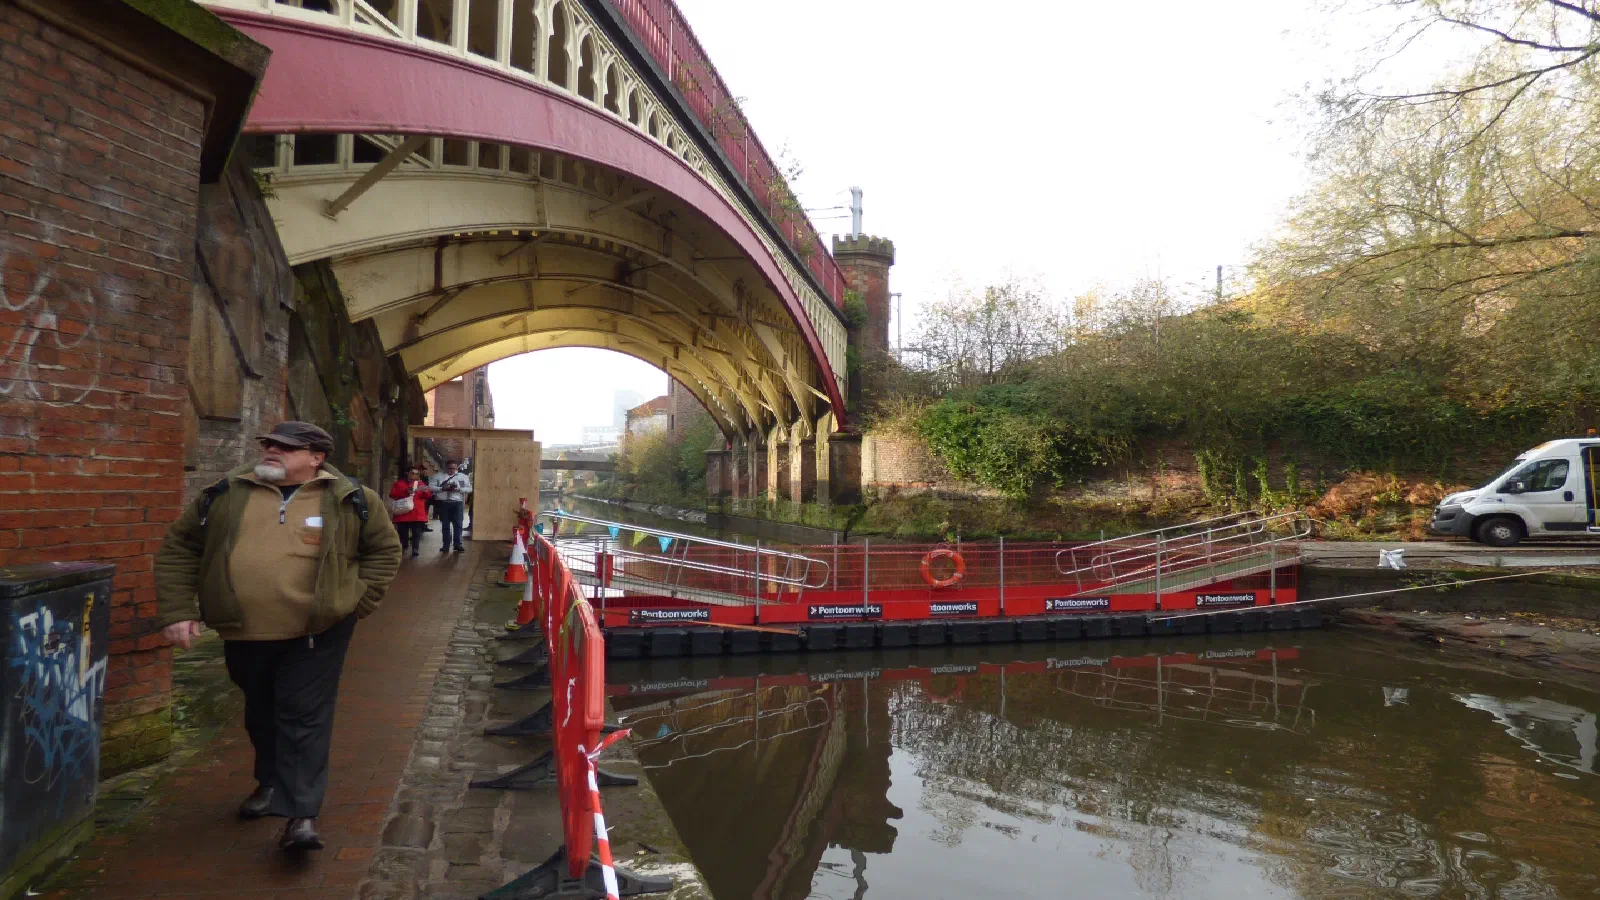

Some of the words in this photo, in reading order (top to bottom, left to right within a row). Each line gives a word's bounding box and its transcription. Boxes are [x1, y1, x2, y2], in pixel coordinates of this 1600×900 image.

[1054, 598, 1109, 607] Pontoonworks
[1205, 594, 1254, 603] Pontoonworks
[818, 605, 880, 615] Pontoonwrks
